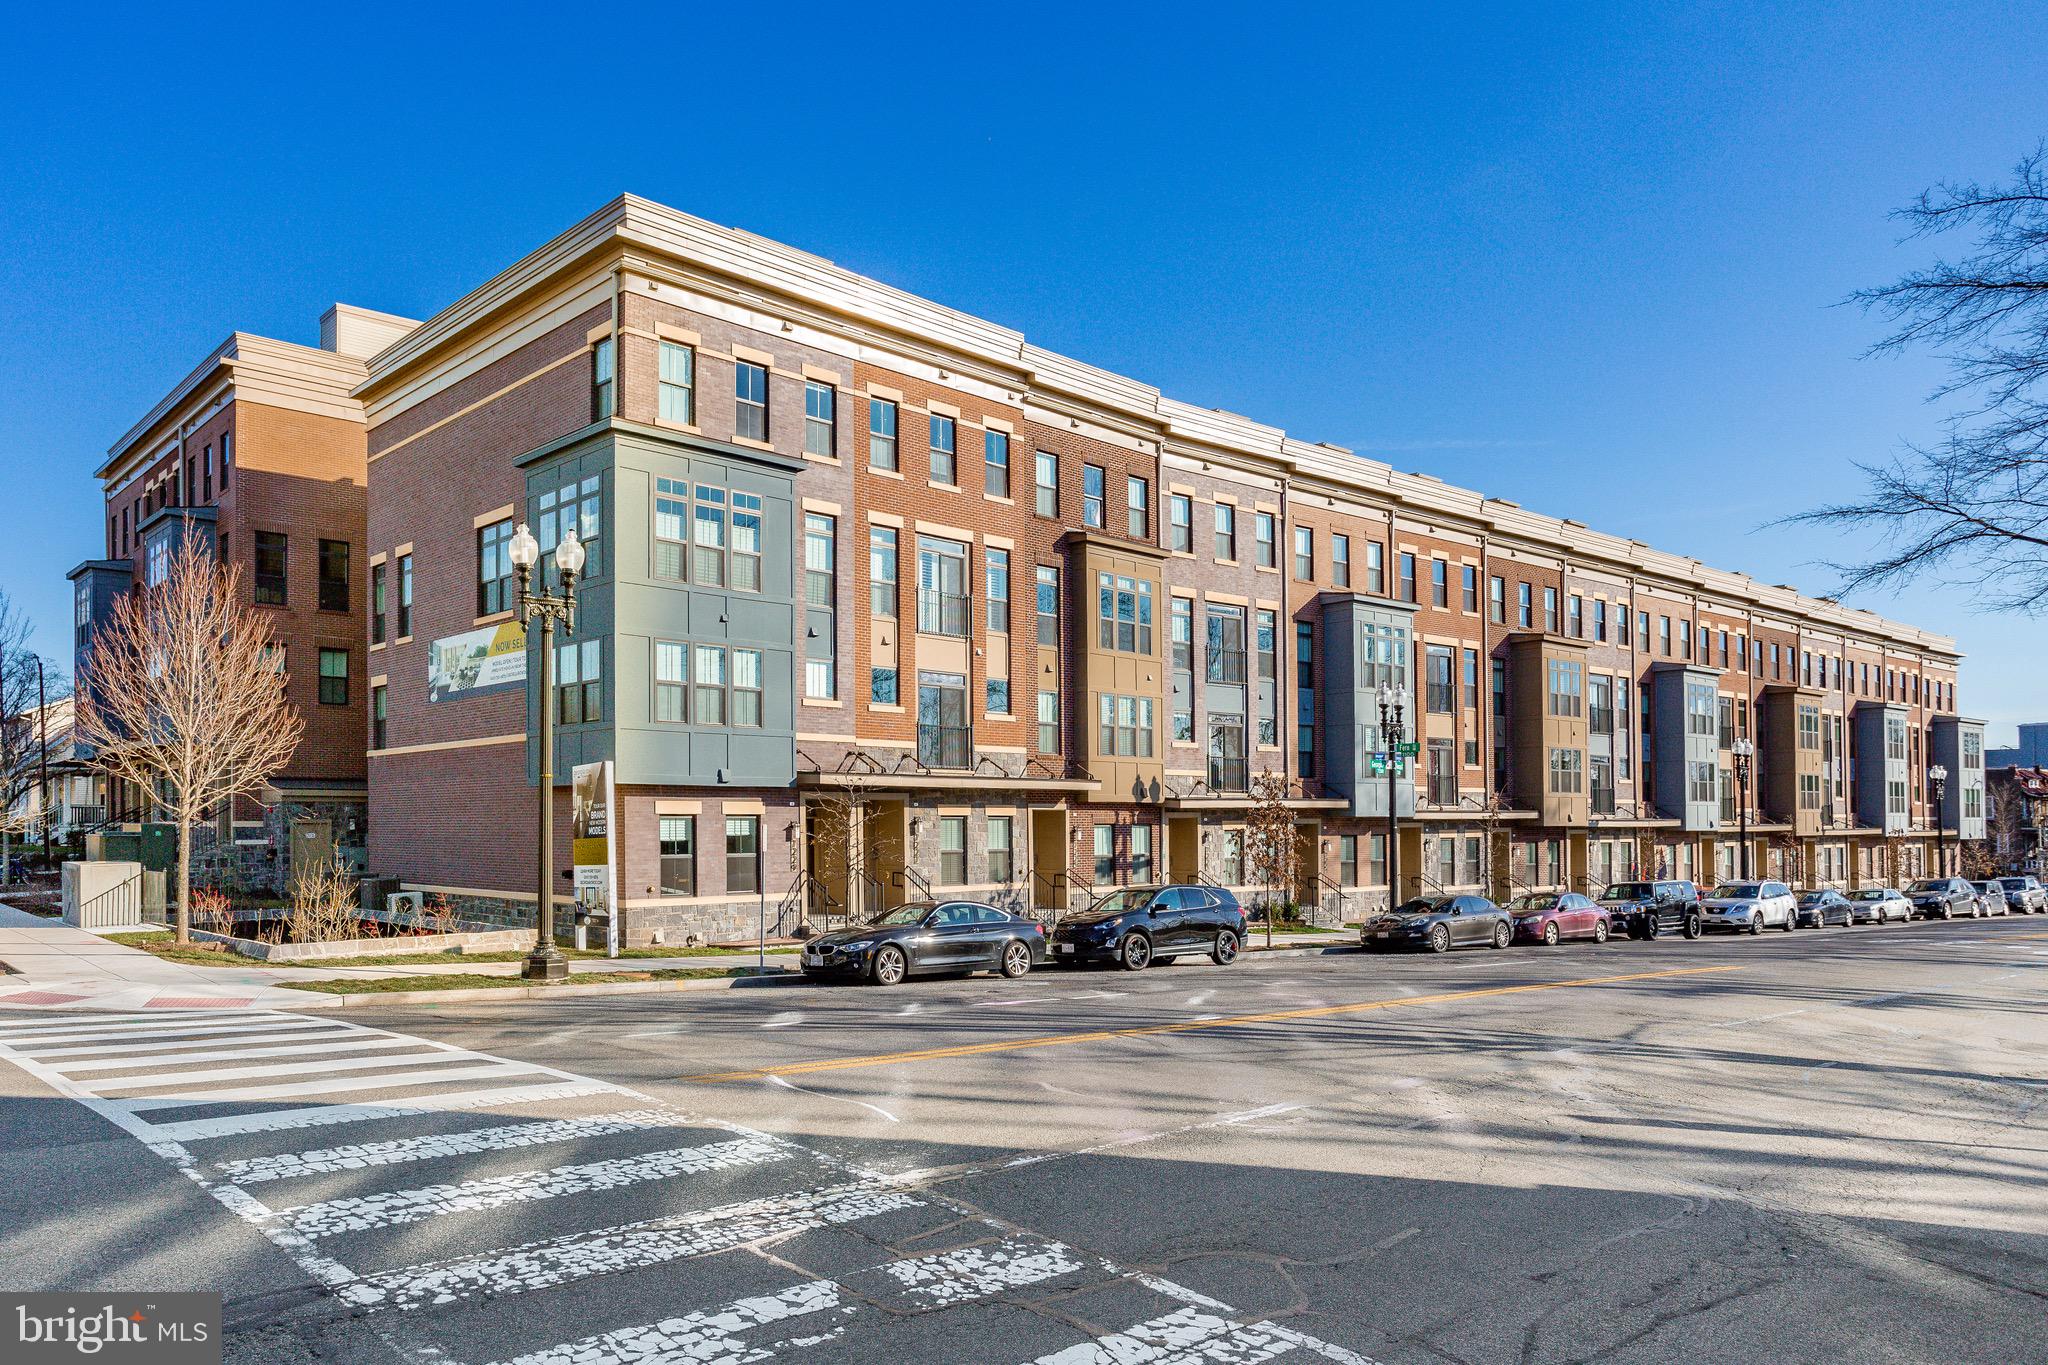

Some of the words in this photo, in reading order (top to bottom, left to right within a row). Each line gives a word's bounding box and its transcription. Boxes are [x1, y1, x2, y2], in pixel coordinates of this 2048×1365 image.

[496, 642, 510, 652] NOW
[590, 810, 606, 819] BRAND
[588, 826, 606, 835] MODELS
